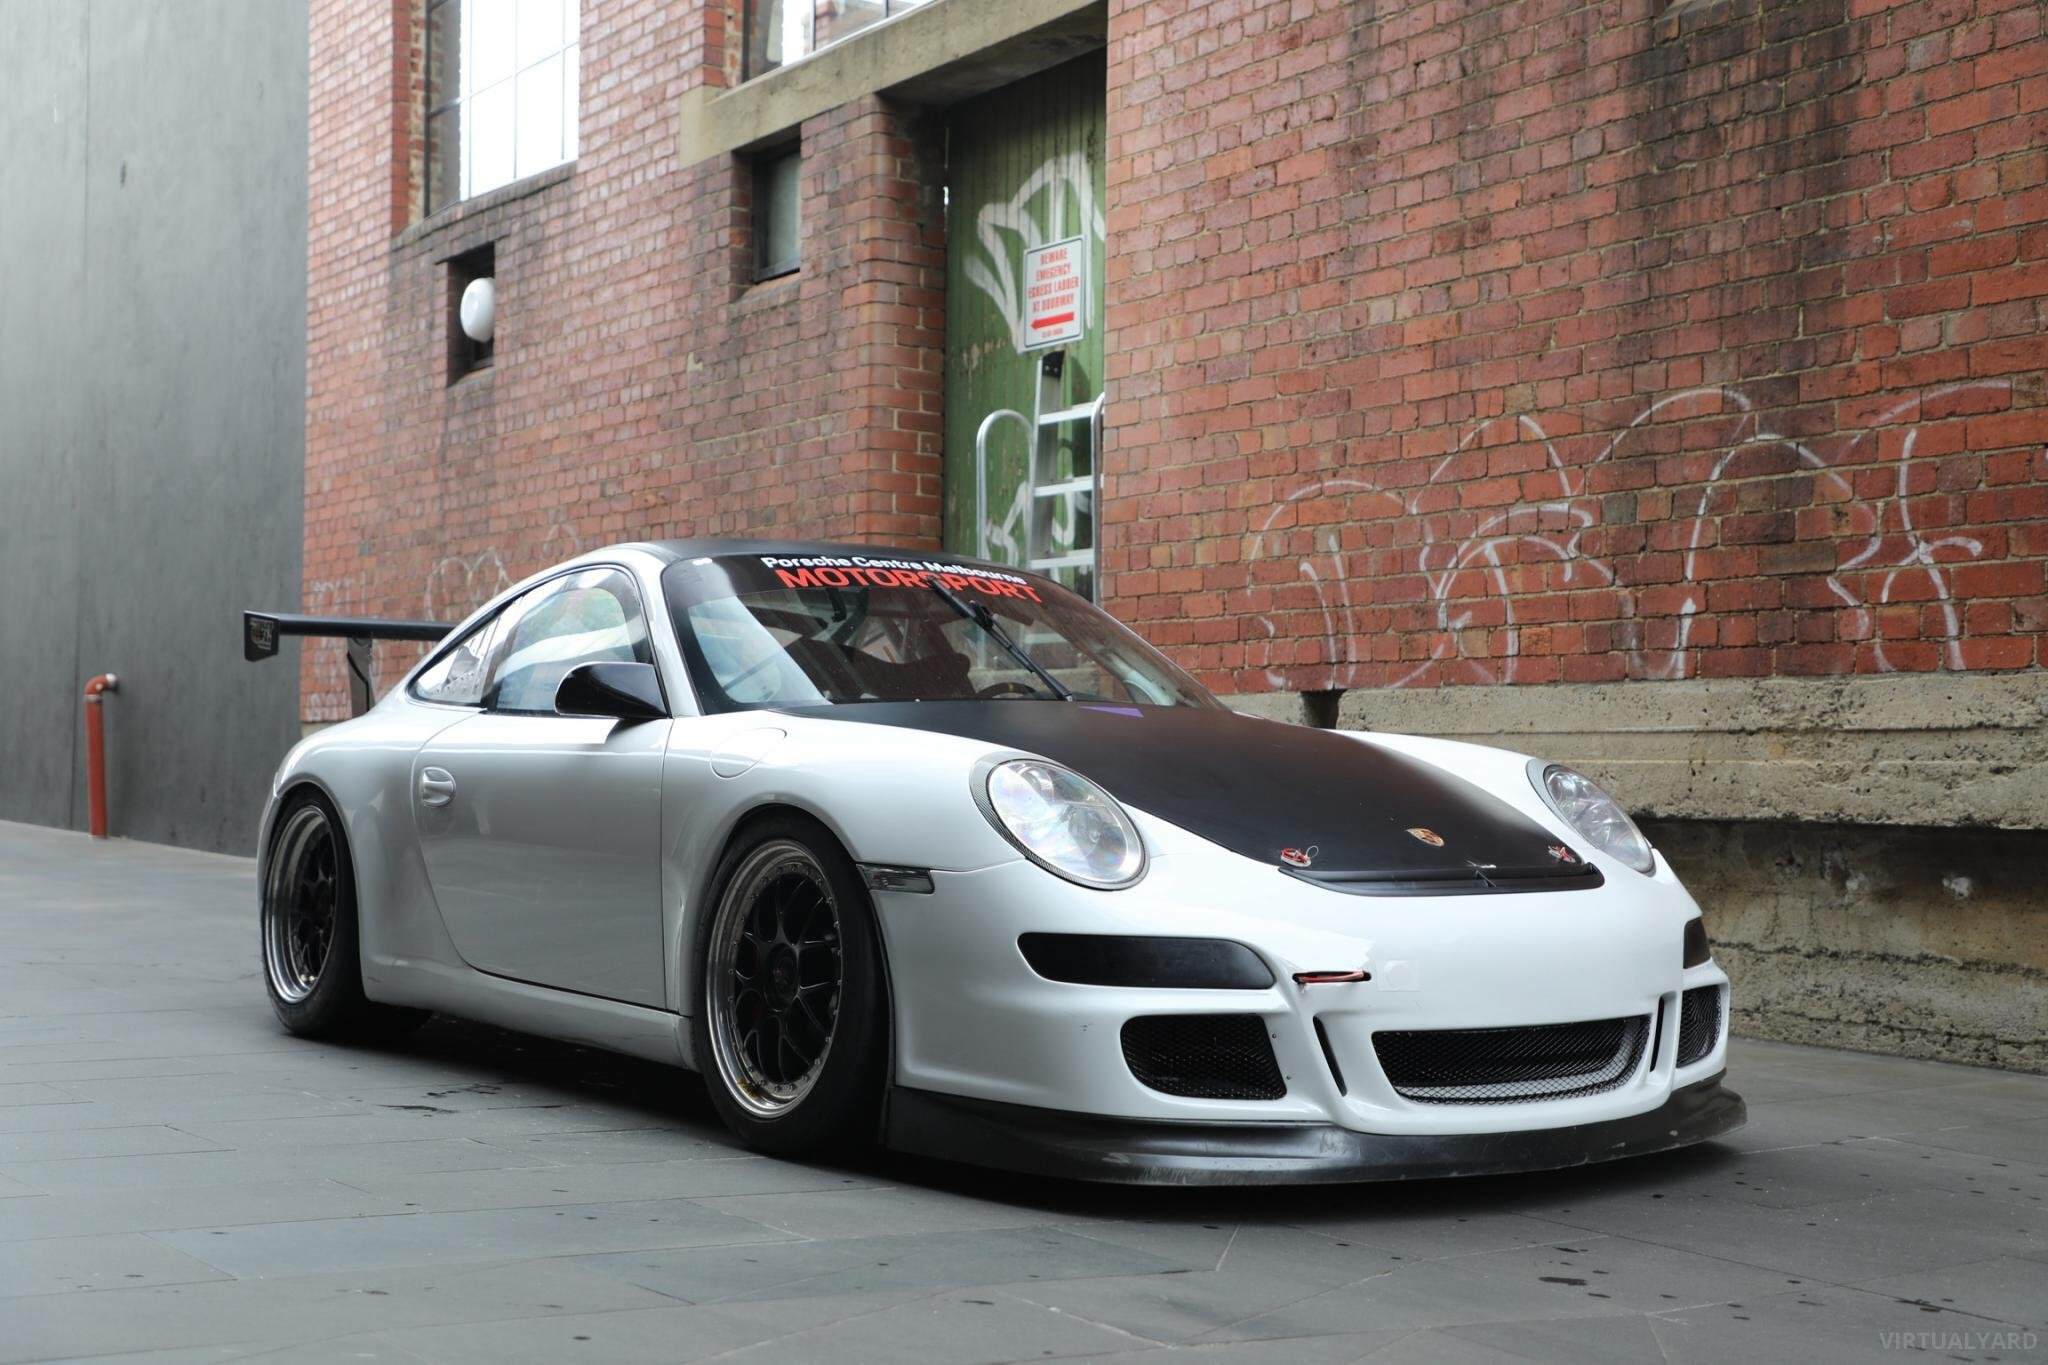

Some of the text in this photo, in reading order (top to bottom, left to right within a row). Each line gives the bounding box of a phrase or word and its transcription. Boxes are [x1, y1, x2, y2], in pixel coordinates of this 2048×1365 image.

[1040, 247, 1067, 265] BEWARE
[1054, 276, 1079, 293] LADDER
[760, 556, 1028, 585] Porsche Centre Melbourne
[774, 567, 1042, 603] MOTORSPORT
